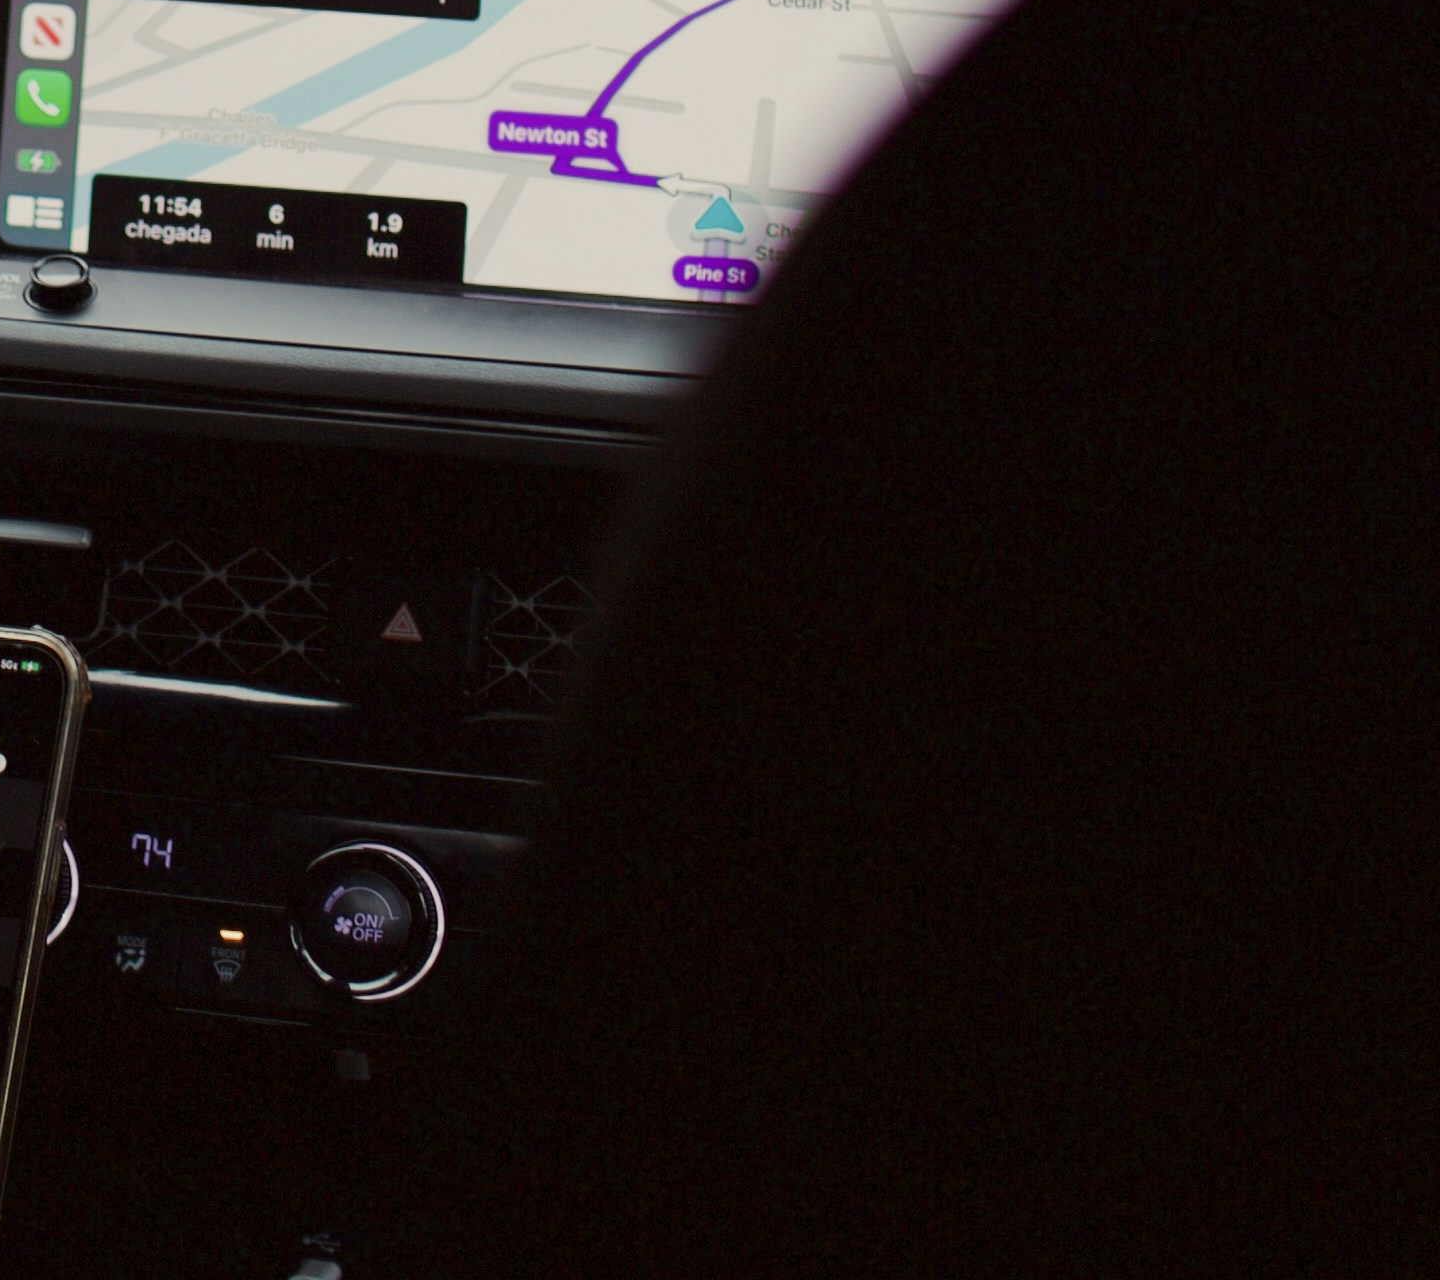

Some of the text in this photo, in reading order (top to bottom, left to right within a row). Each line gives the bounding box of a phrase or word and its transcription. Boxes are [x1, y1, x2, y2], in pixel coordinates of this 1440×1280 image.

[207, 106, 277, 128] Charles
[260, 132, 318, 154] Bridge
[497, 122, 608, 149] Newton St
[138, 194, 203, 219] 11:54
[268, 203, 285, 225] 6
[124, 219, 213, 245] chegada
[366, 211, 404, 234] 1.9
[256, 230, 295, 251] min
[366, 238, 399, 259] km
[683, 262, 747, 285] Pine St
[129, 831, 174, 870] 74
[352, 913, 385, 929] ON/
[351, 928, 384, 944] OFF
